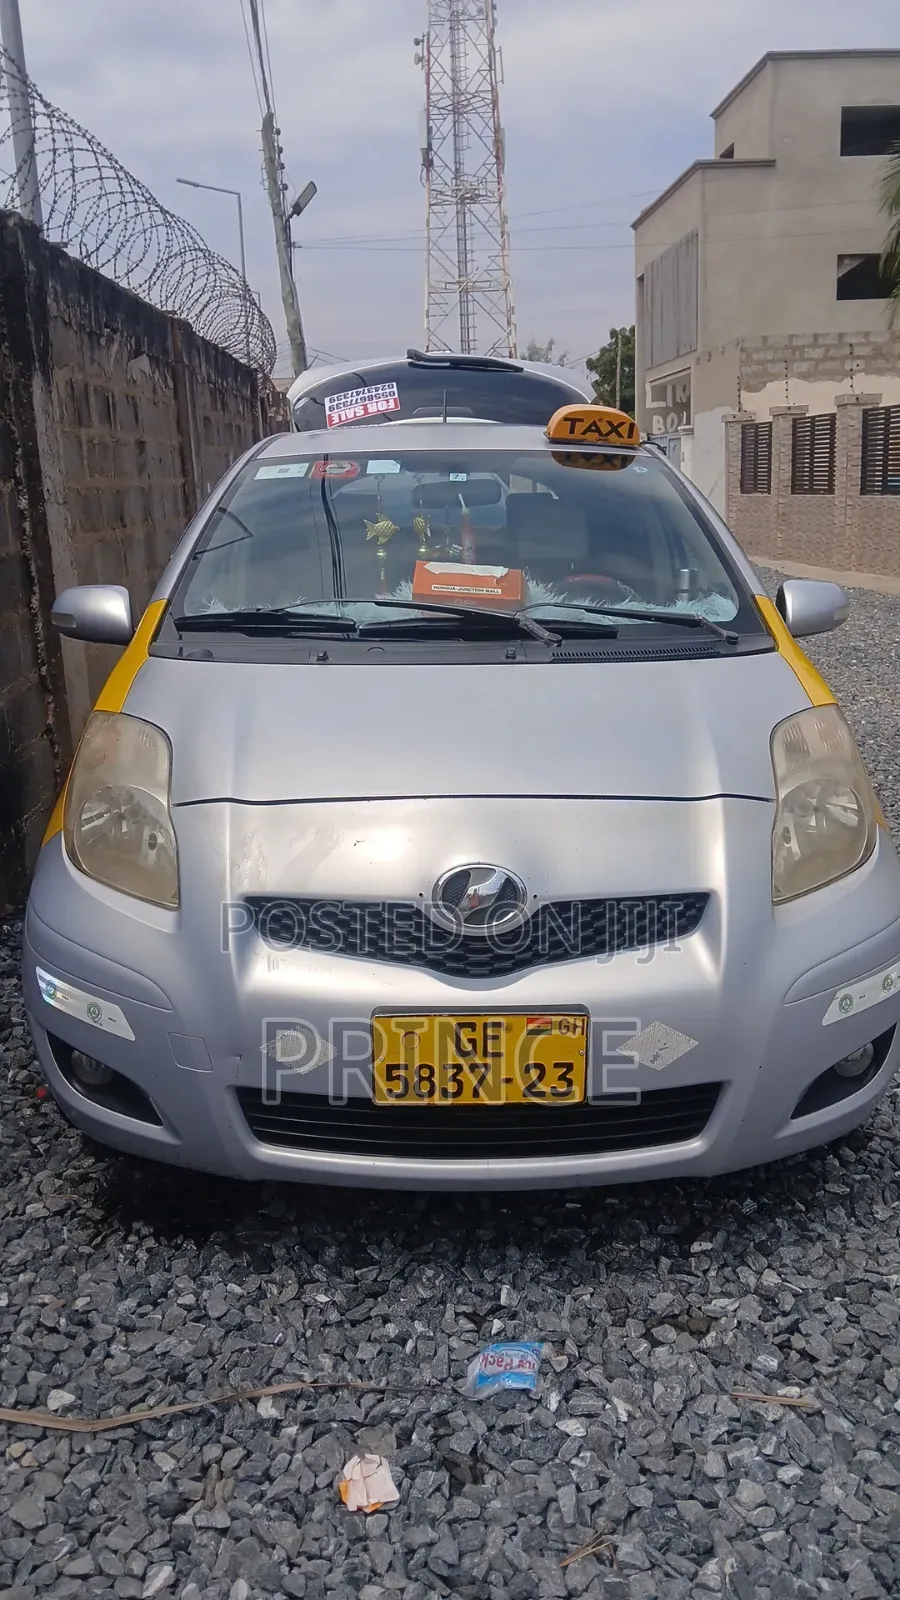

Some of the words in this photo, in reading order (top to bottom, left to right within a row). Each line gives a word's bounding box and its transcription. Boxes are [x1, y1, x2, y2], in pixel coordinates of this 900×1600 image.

[331, 405, 365, 425] SALE
[367, 399, 396, 413] FOR
[563, 417, 636, 439] TAXI
[454, 1021, 504, 1058] GE
[558, 1017, 586, 1037] GH
[385, 1062, 575, 1099] 5837-23
